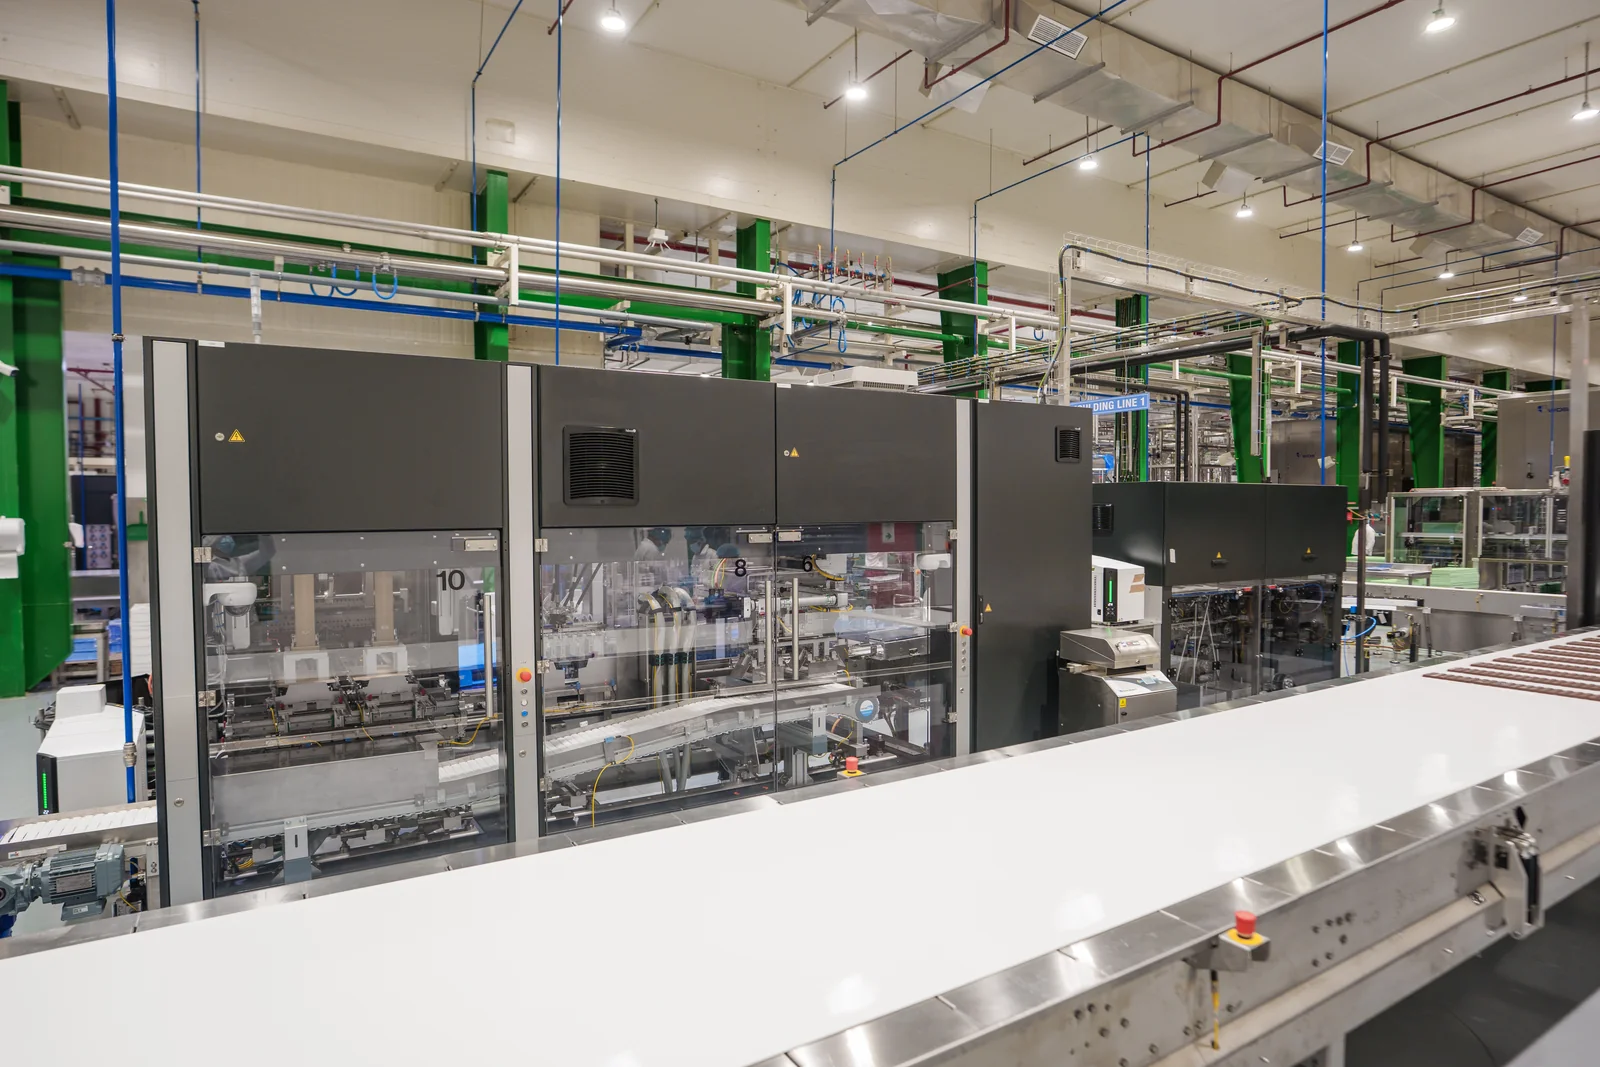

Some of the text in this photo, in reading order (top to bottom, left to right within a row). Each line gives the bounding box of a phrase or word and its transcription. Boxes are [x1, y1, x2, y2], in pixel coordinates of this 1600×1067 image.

[1117, 398, 1137, 409] LINE
[1140, 397, 1145, 406] 1
[735, 559, 747, 577] 8
[803, 556, 813, 572] 6
[436, 570, 465, 591] 10
